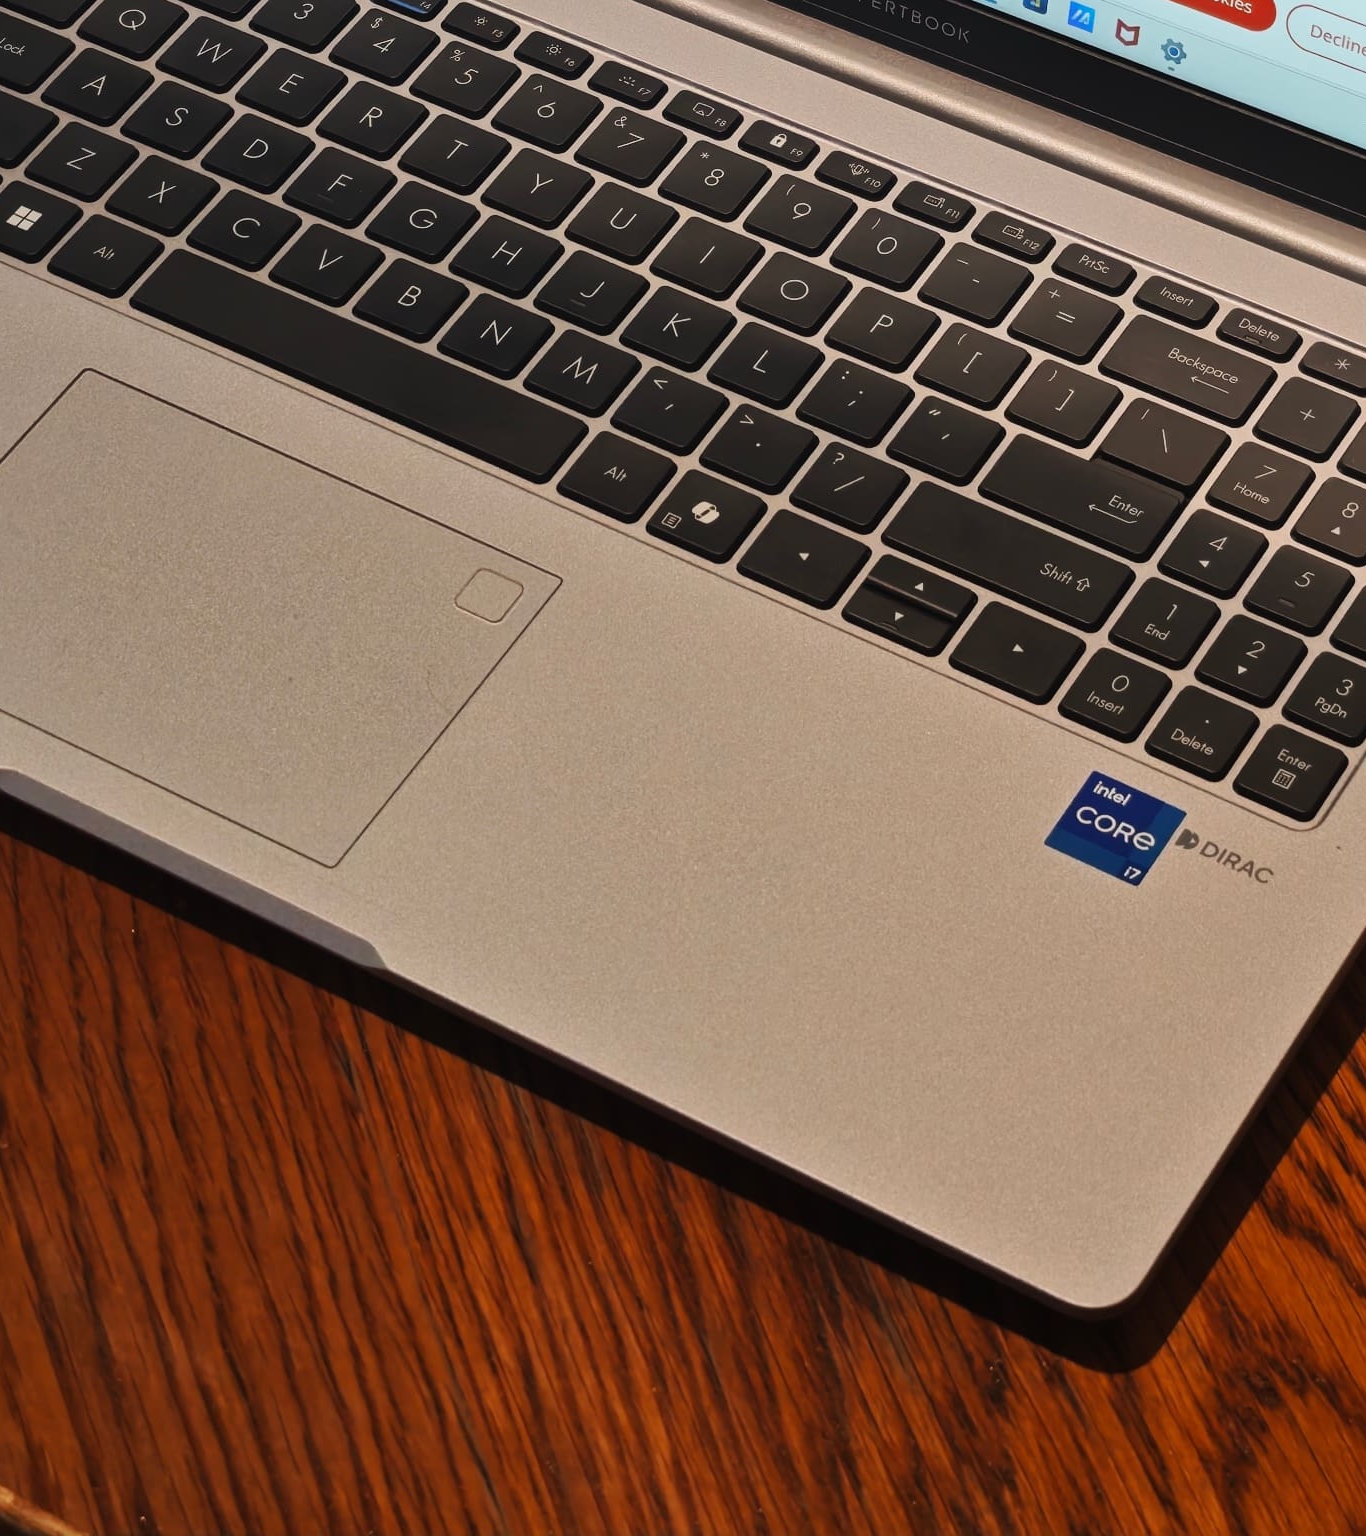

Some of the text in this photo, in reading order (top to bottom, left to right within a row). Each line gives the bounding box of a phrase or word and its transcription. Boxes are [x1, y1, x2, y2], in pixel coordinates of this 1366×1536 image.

[1078, 253, 1109, 274] PrtSc
[1159, 286, 1194, 306] Insert
[1237, 317, 1280, 341] Delete
[1167, 347, 1238, 384] Backspace
[1232, 481, 1270, 504] Home
[1107, 494, 1144, 517] Enter
[1039, 562, 1073, 584] Shift
[1086, 690, 1124, 715] Insert
[1313, 696, 1347, 718] PgDn
[1170, 727, 1214, 755] Delete
[1276, 748, 1312, 771] Enter
[1093, 781, 1132, 806] intel
[1199, 841, 1275, 884] DIRAC
